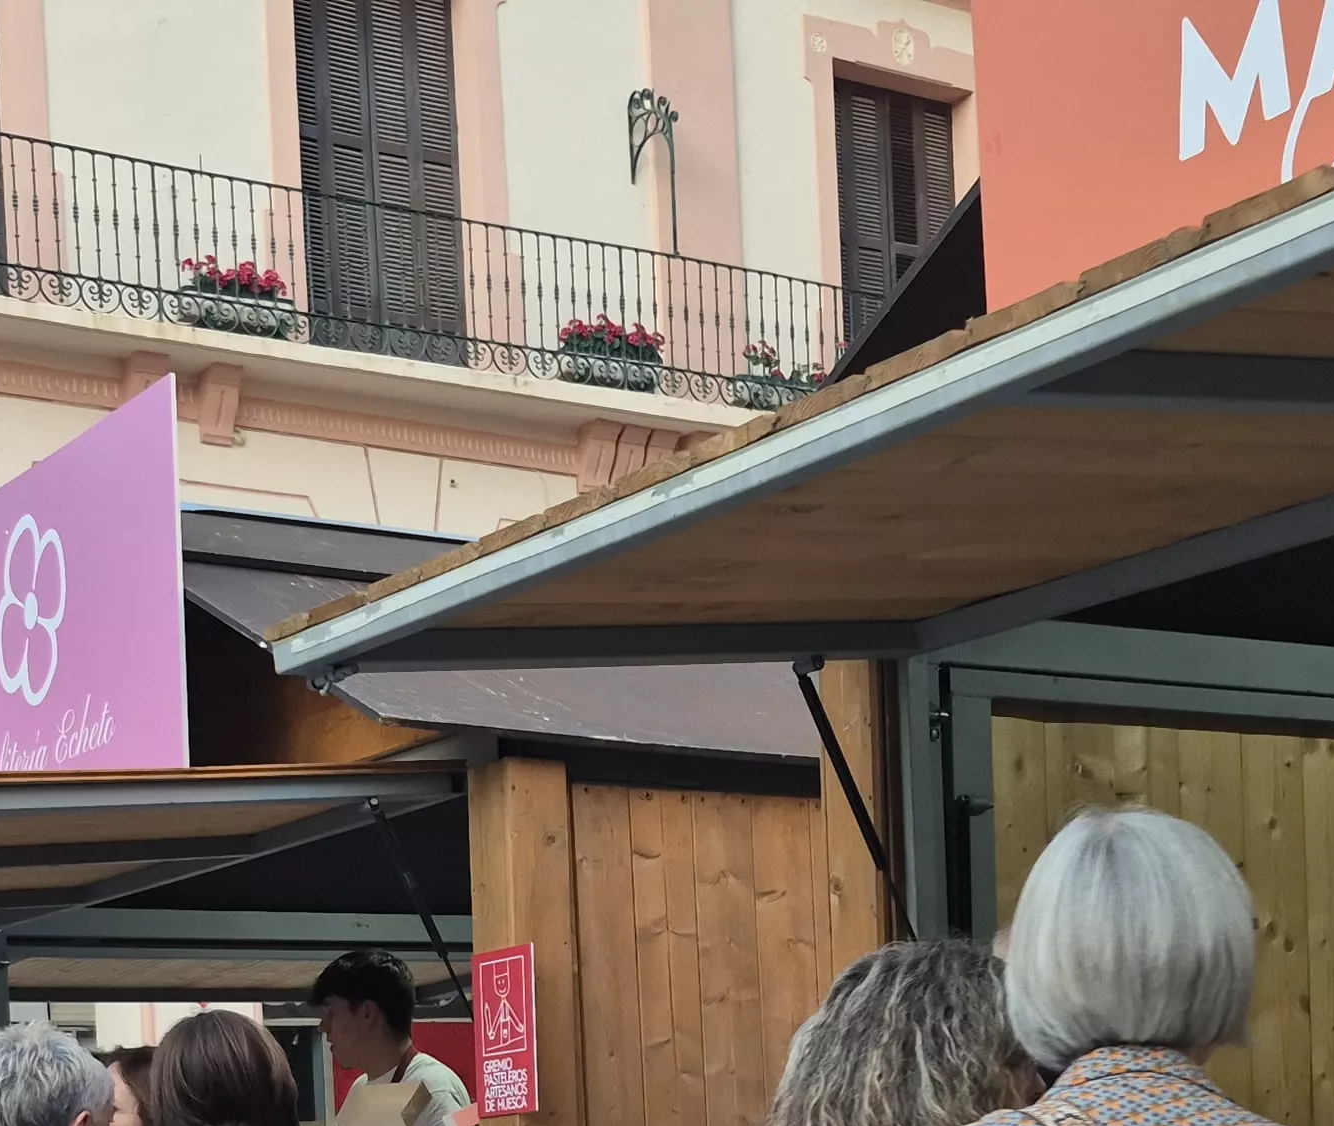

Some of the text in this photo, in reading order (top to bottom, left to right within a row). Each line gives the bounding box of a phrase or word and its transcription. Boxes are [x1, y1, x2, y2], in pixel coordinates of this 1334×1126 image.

[55, 693, 117, 768] Echeto
[483, 1057, 513, 1073] GREMIO
[484, 1068, 528, 1086] PASTELEROS
[485, 1082, 528, 1099] ARTESANOS
[485, 1096, 528, 1112] DE HUESCA
